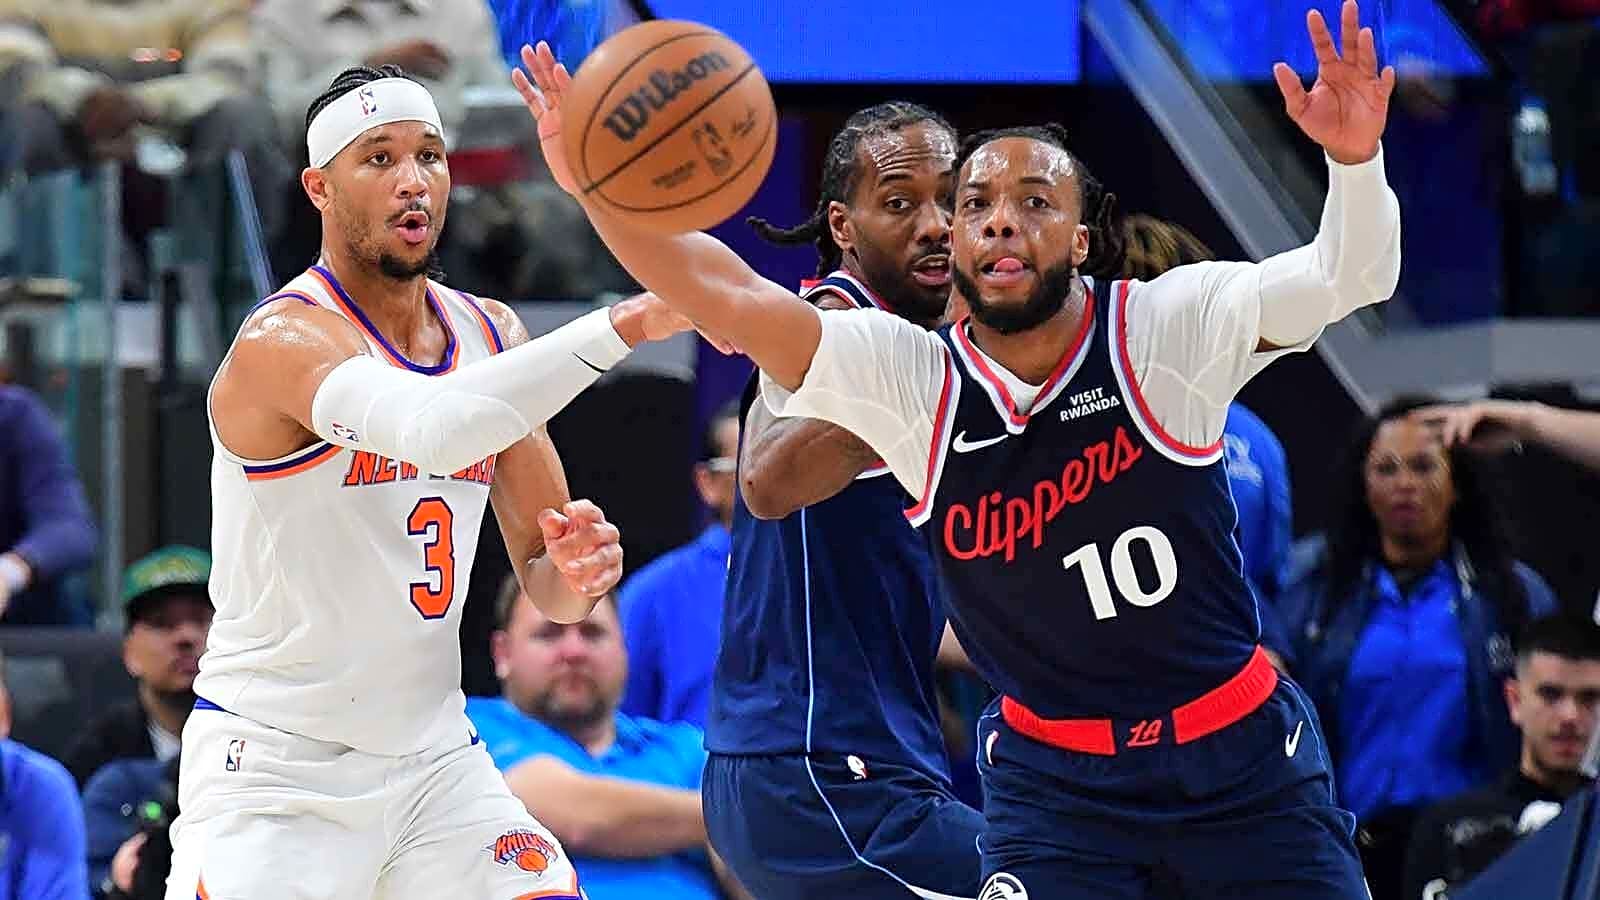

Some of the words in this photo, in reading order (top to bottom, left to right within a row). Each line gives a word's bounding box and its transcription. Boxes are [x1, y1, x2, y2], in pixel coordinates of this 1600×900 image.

[602, 51, 731, 142] Wilson
[1060, 395, 1121, 422] RWANDA
[1069, 387, 1104, 406] VISIT
[943, 425, 1143, 562] Clippers
[407, 496, 455, 620] 3
[1062, 525, 1178, 620] 10
[1125, 719, 1162, 747] LA
